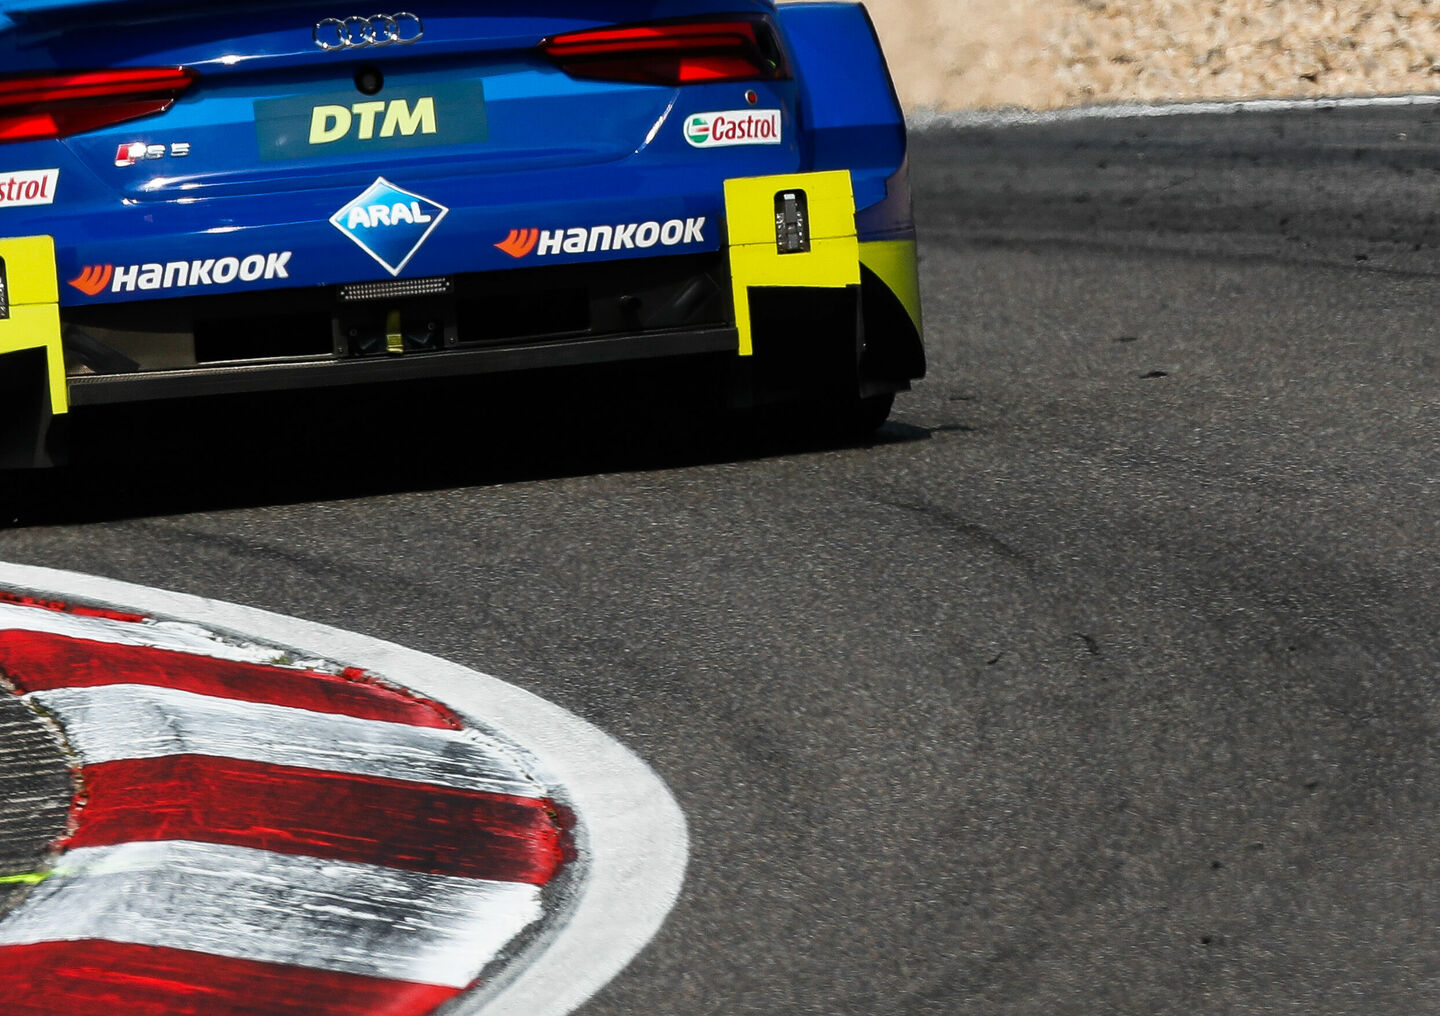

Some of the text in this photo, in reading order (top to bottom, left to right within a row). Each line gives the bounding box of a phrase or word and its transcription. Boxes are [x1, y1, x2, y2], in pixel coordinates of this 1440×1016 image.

[309, 96, 437, 144] DTM
[712, 114, 778, 141] Castrol
[170, 142, 190, 156] 5
[347, 201, 432, 230] ARAL
